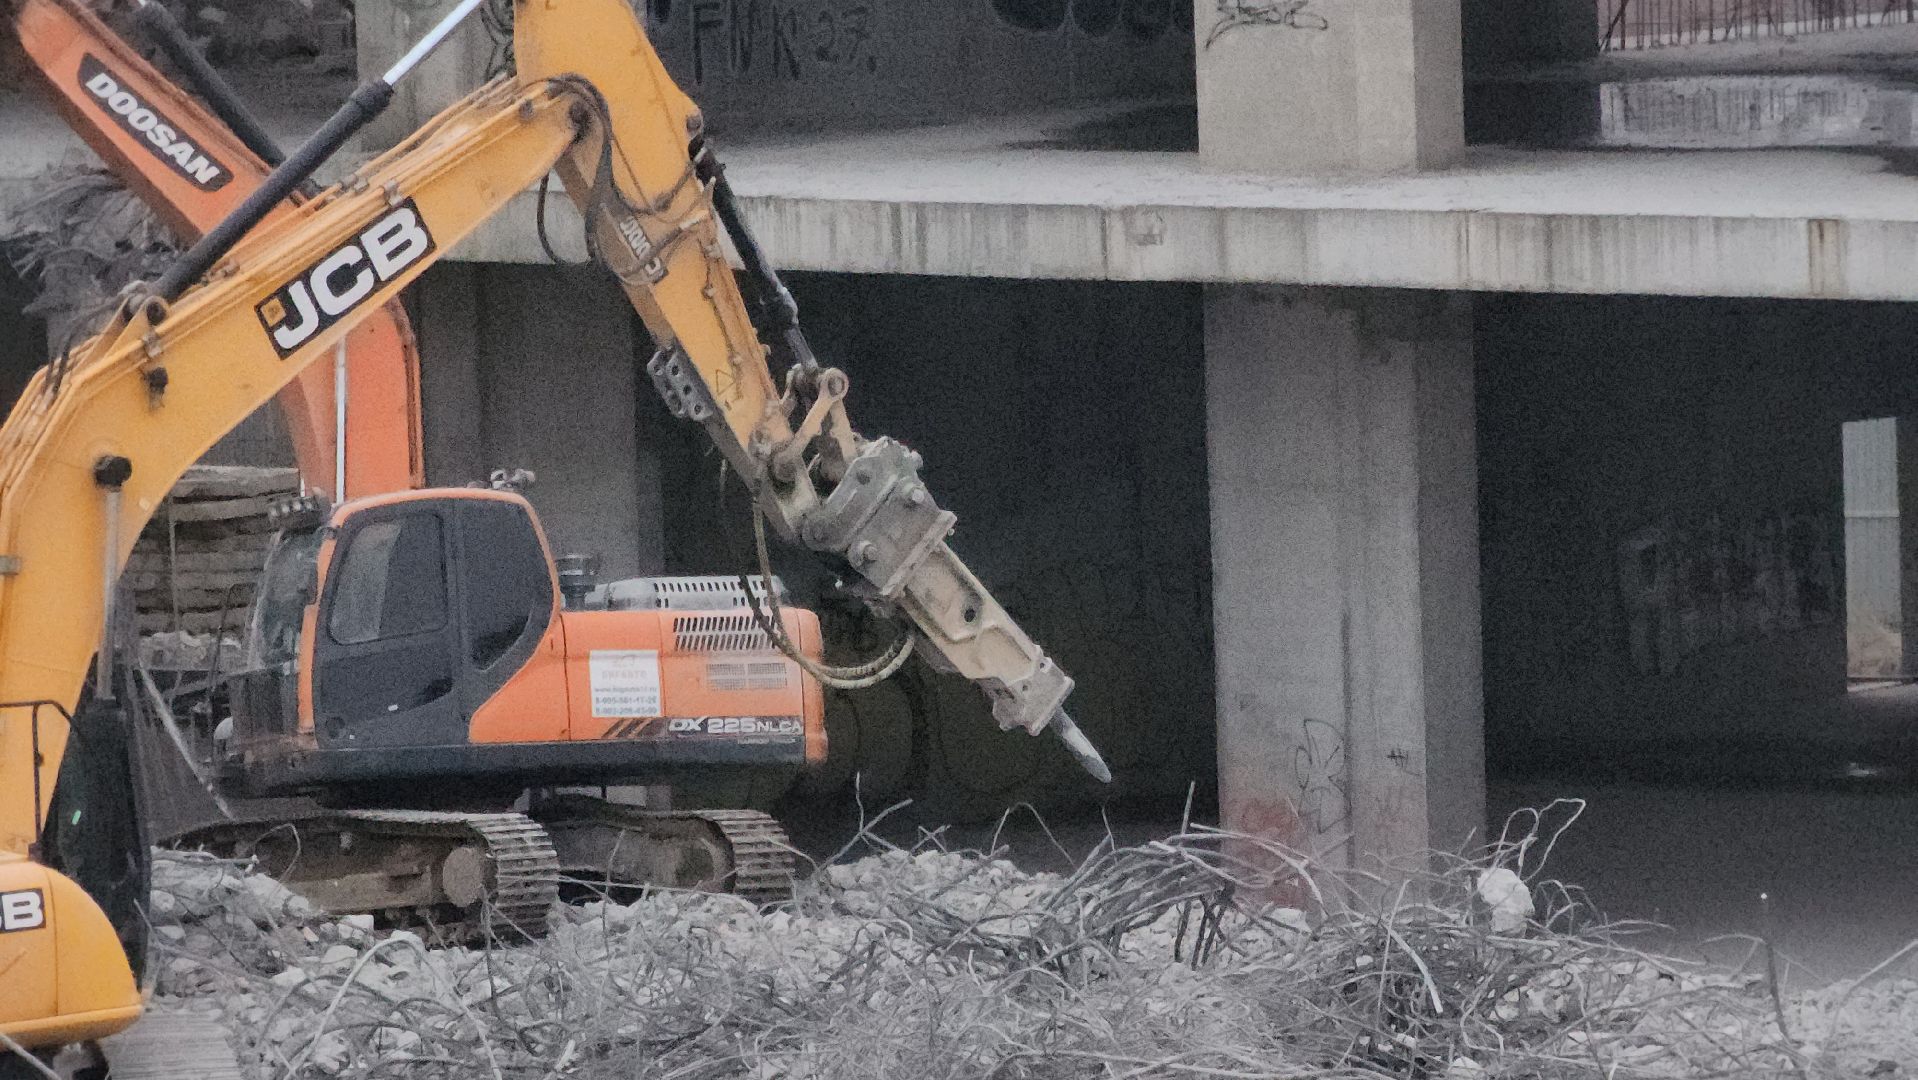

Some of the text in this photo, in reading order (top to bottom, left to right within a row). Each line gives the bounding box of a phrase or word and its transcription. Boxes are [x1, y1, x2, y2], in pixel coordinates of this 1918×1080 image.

[84, 71, 221, 184] DOOSAN
[272, 207, 429, 349] JCB
[669, 716, 708, 732] DX
[0, 891, 43, 930] B
